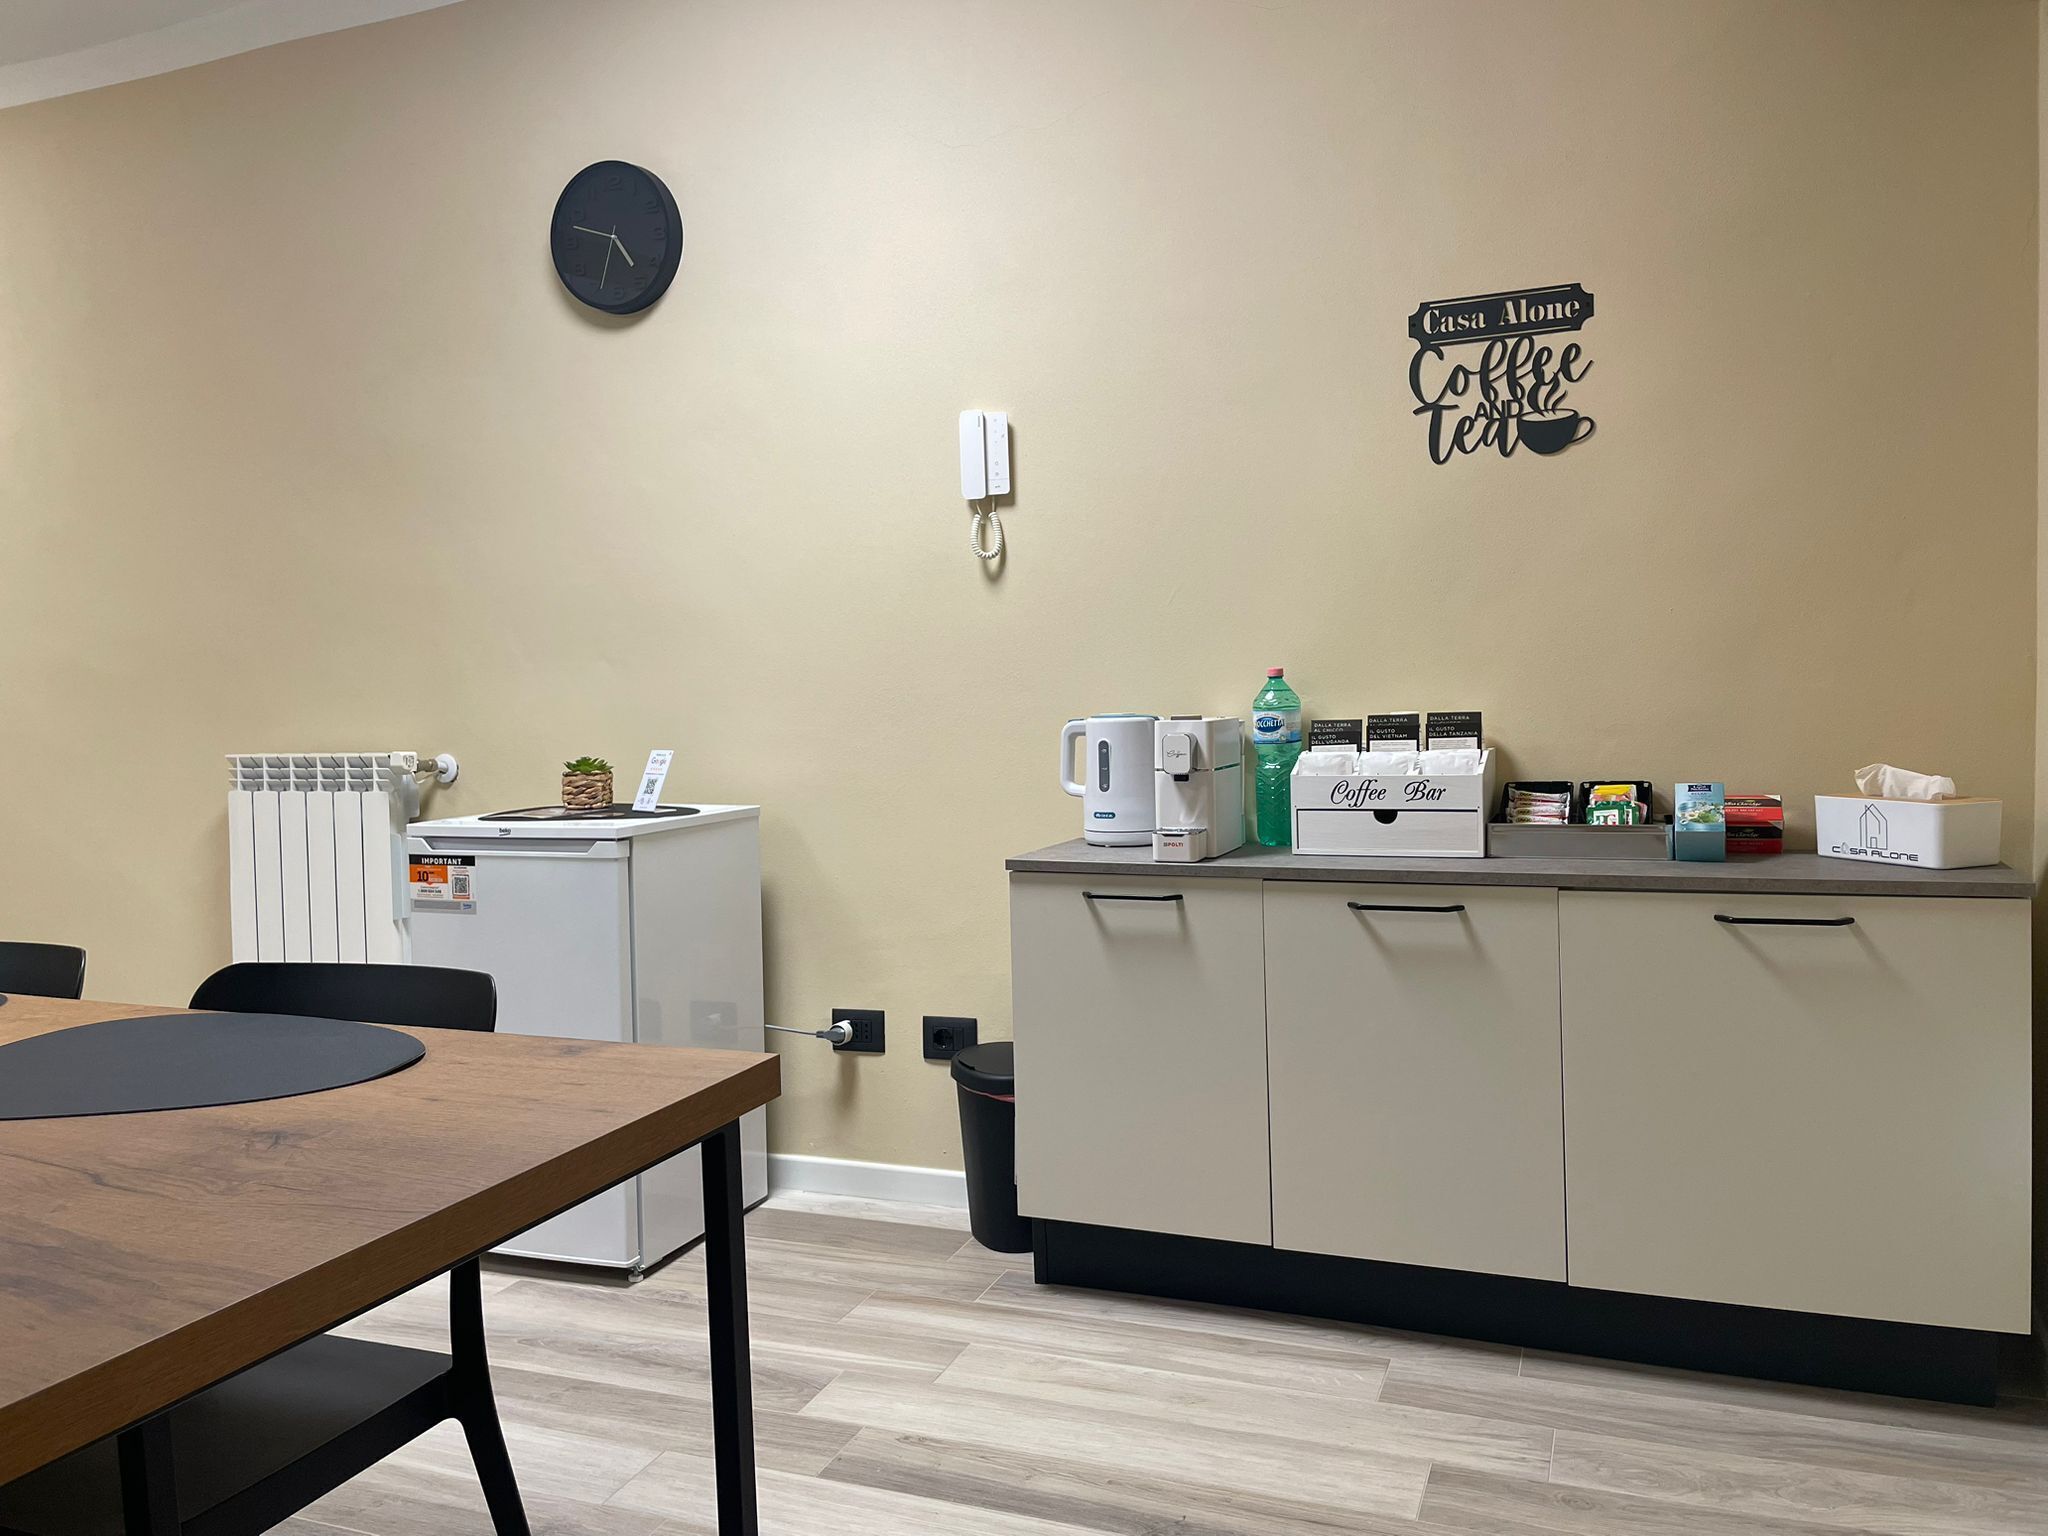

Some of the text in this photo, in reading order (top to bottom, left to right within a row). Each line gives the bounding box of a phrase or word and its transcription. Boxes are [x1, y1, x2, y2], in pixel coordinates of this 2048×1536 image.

[1422, 298, 1581, 335] Casa Alone
[1408, 336, 1594, 405] Coffee
[1474, 399, 1524, 421] AND
[1412, 404, 1520, 465] Tea
[1255, 719, 1286, 729] OCCHETTA
[1330, 779, 1446, 808] Coffee Bar
[421, 857, 462, 865] IMPORTANT
[1871, 849, 1919, 862] ALONE
[417, 870, 429, 882] 10
